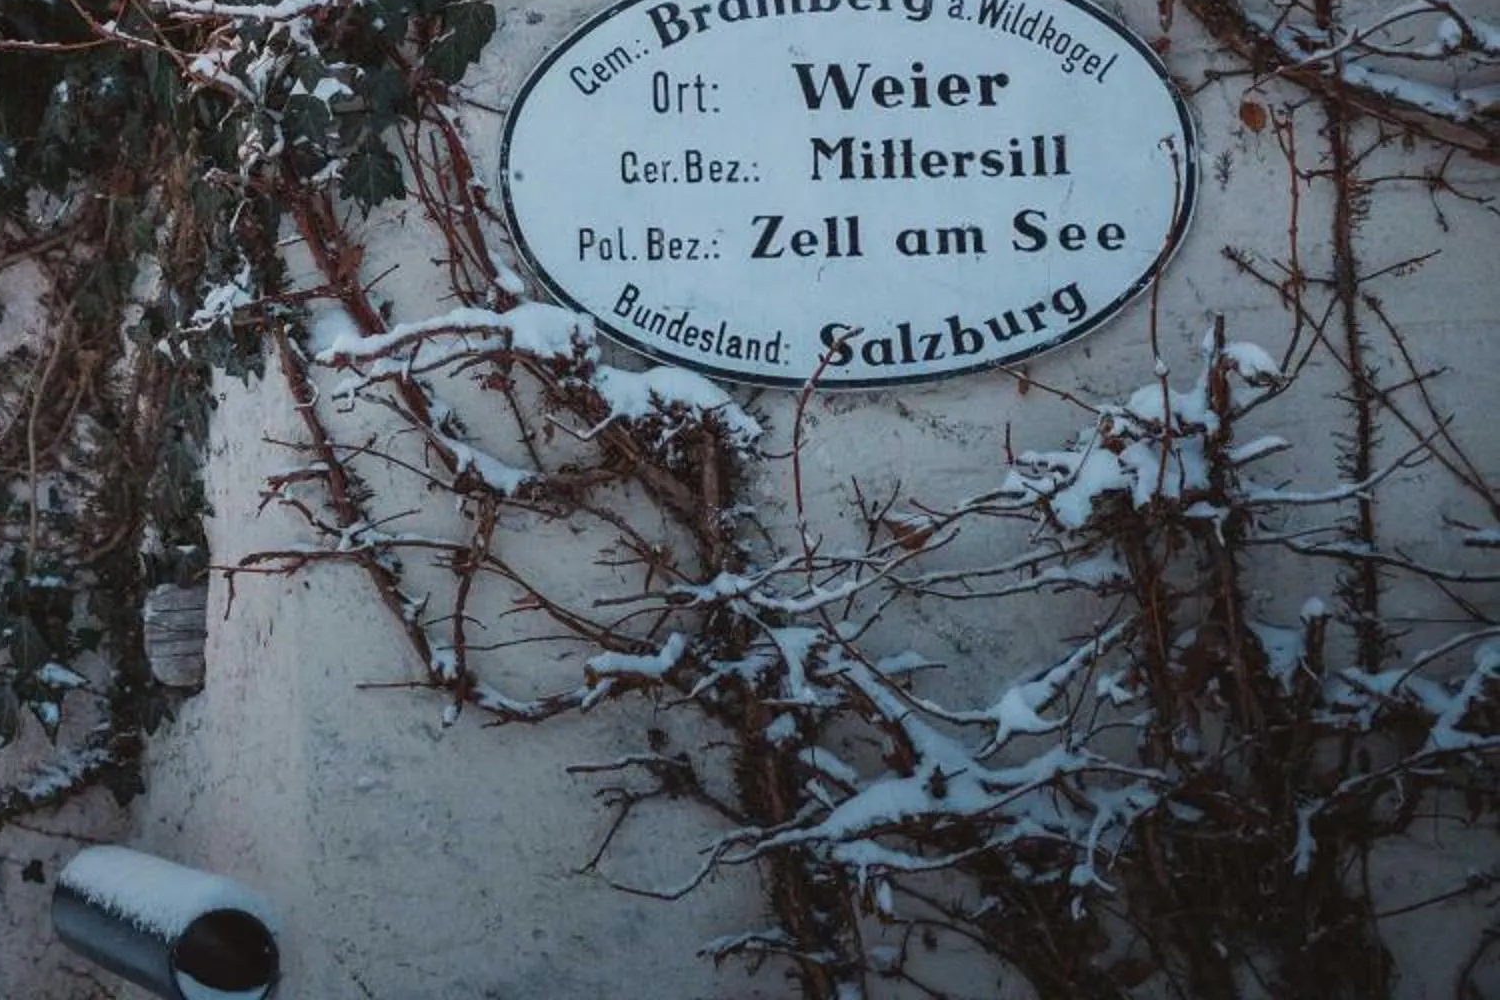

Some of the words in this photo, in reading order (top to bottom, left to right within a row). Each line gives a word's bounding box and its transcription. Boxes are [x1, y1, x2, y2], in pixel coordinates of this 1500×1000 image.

[653, 70, 721, 114] Ort:
[792, 61, 1010, 110] Weier
[810, 134, 1072, 181] Mittersill
[751, 215, 864, 260] Zell
[896, 222, 988, 258] am
[1012, 208, 1126, 253] See
[612, 281, 792, 366] Bundesland:
[818, 280, 1088, 367] Salzburg
